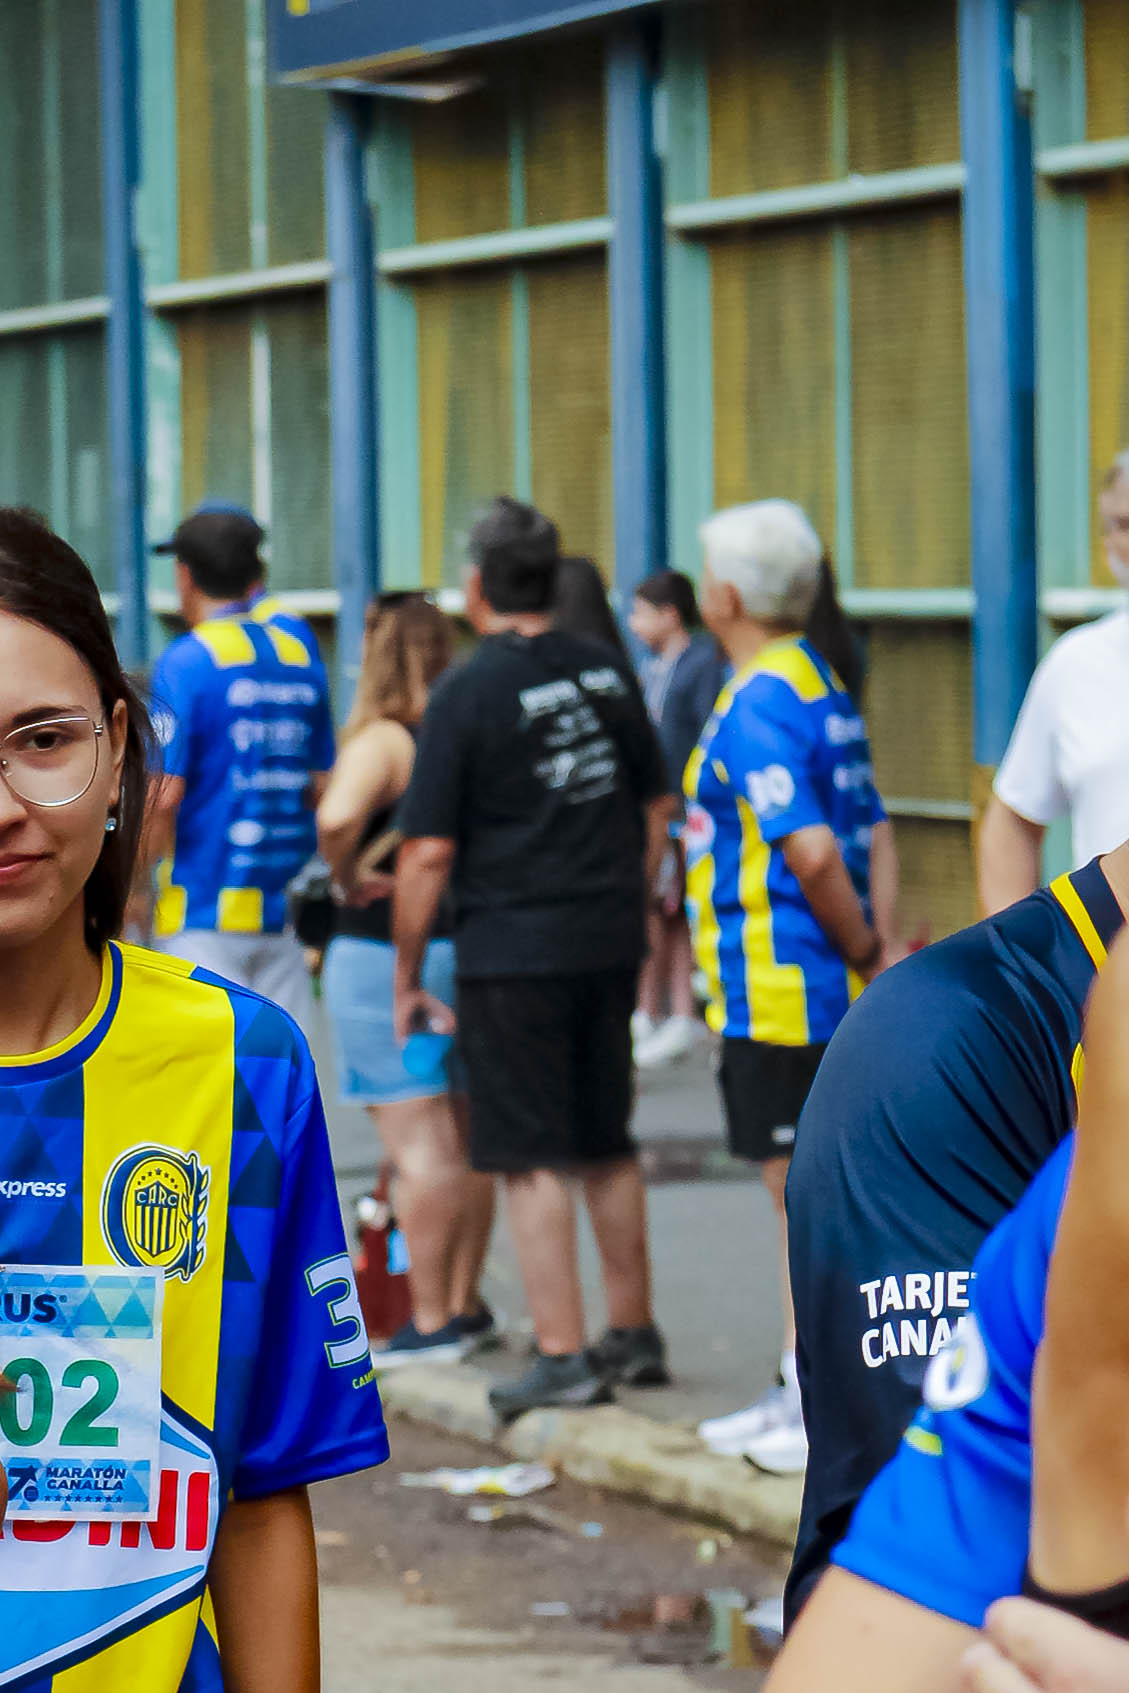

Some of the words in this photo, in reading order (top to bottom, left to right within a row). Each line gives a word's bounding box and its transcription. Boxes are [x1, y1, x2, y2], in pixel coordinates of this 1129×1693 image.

[136, 1184, 178, 1207] CARC
[860, 1271, 977, 1319] TARJE
[861, 1317, 970, 1368] CANA
[46, 1464, 126, 1479] MARATÓN
[47, 1479, 124, 1491] CANALLA
